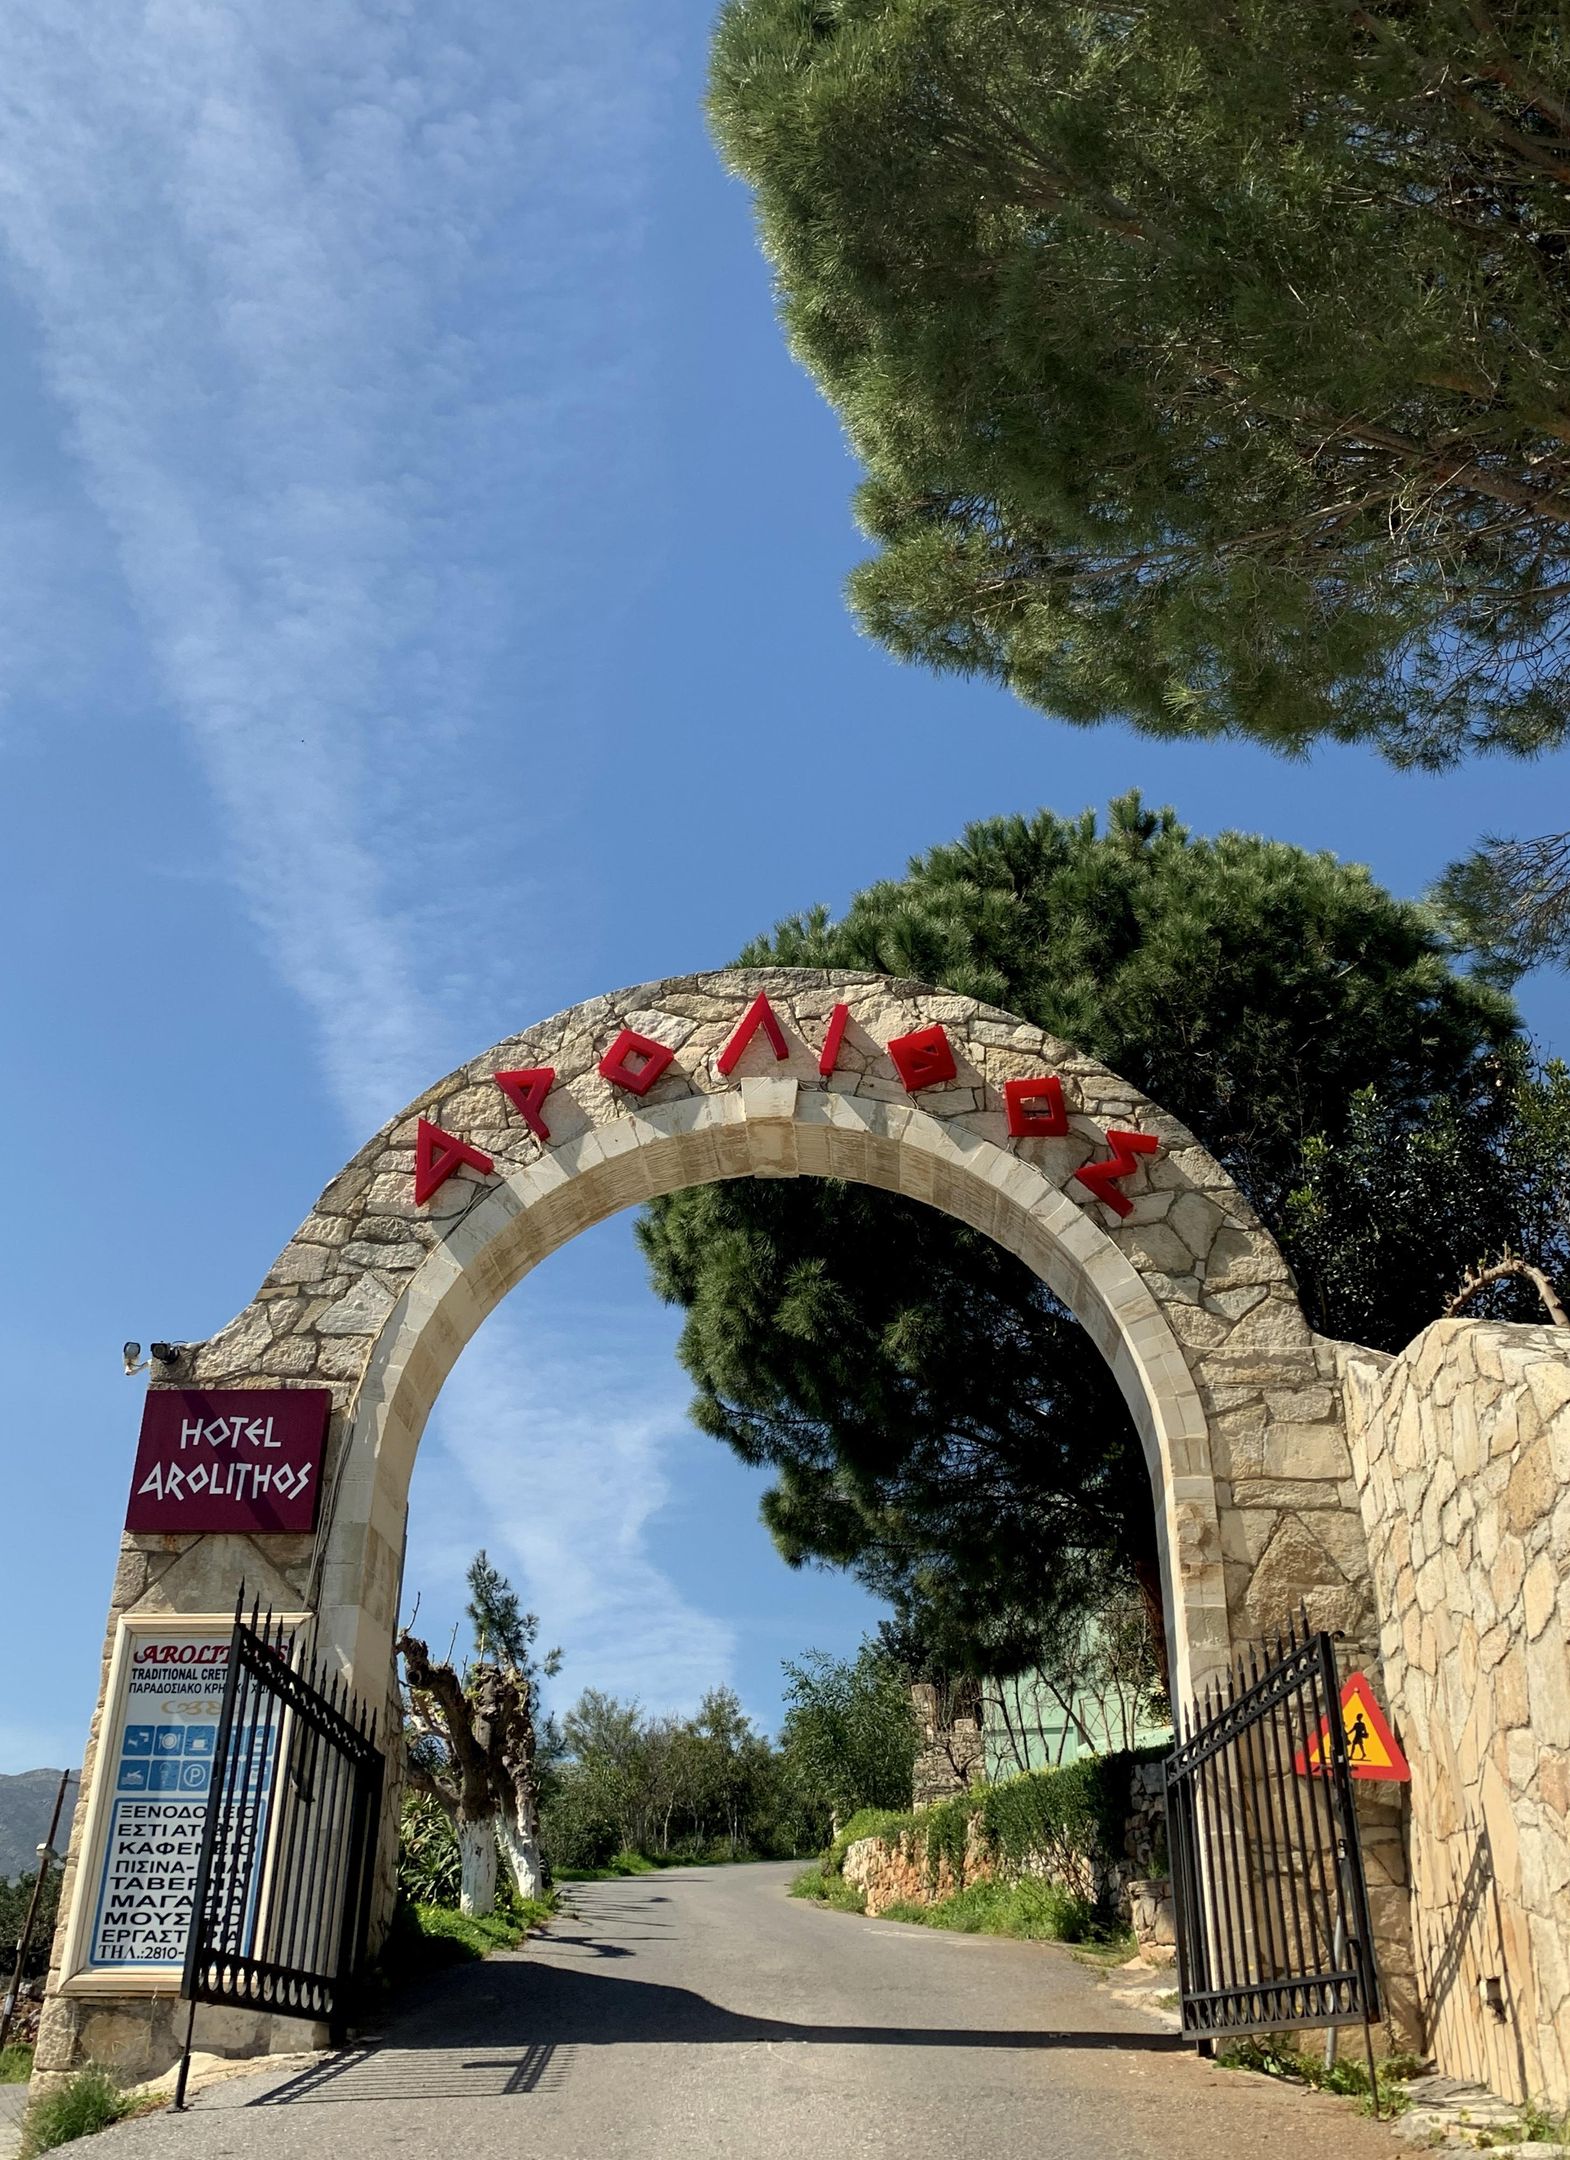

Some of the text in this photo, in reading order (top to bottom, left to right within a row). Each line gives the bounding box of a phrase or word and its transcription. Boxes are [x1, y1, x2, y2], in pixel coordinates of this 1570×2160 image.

[179, 1416, 282, 1450] HOTEL
[136, 1461, 313, 1502] AROLITHOS
[134, 1645, 289, 1664] AROLITS
[131, 1668, 198, 1680] TRADITIONAL
[201, 1668, 240, 1681] CRET
[129, 1682, 202, 1694] ΠΑΡΑΔΟΣΙΑΚΟ
[120, 1805, 257, 1819] ΞΕΝΟΔΟΕΙΟ
[118, 1824, 258, 1837] ΕΣΤΙΑΤΡΟ
[104, 1912, 242, 1926] ΜΟΥΣΟ
[101, 1929, 241, 1944] ΕΡΓΑΣΤΡΙΑ
